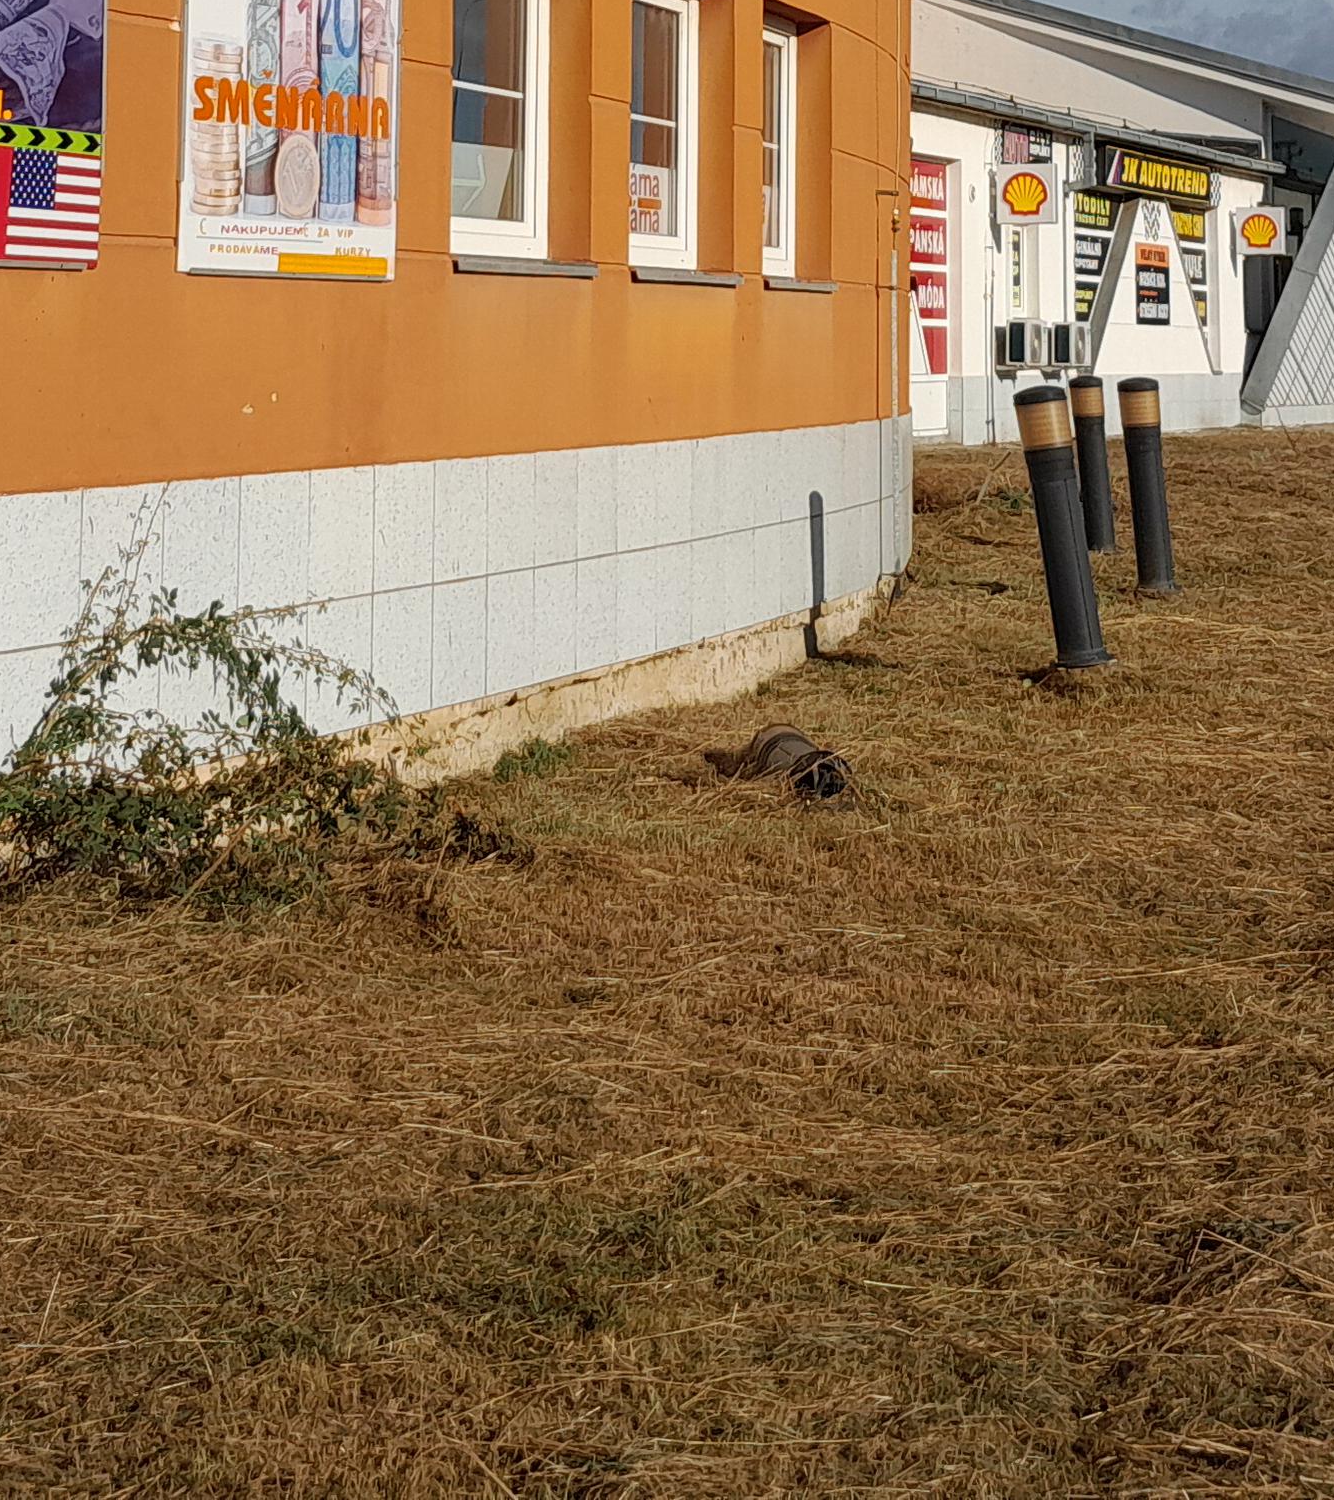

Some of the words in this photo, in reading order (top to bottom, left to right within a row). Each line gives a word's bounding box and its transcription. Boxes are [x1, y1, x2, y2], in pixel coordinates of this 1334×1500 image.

[193, 69, 389, 140] SMĚNÁRNA
[1121, 156, 1139, 184] JK
[1139, 160, 1208, 196] AUTOTREND
[919, 278, 945, 309] MÓDA
